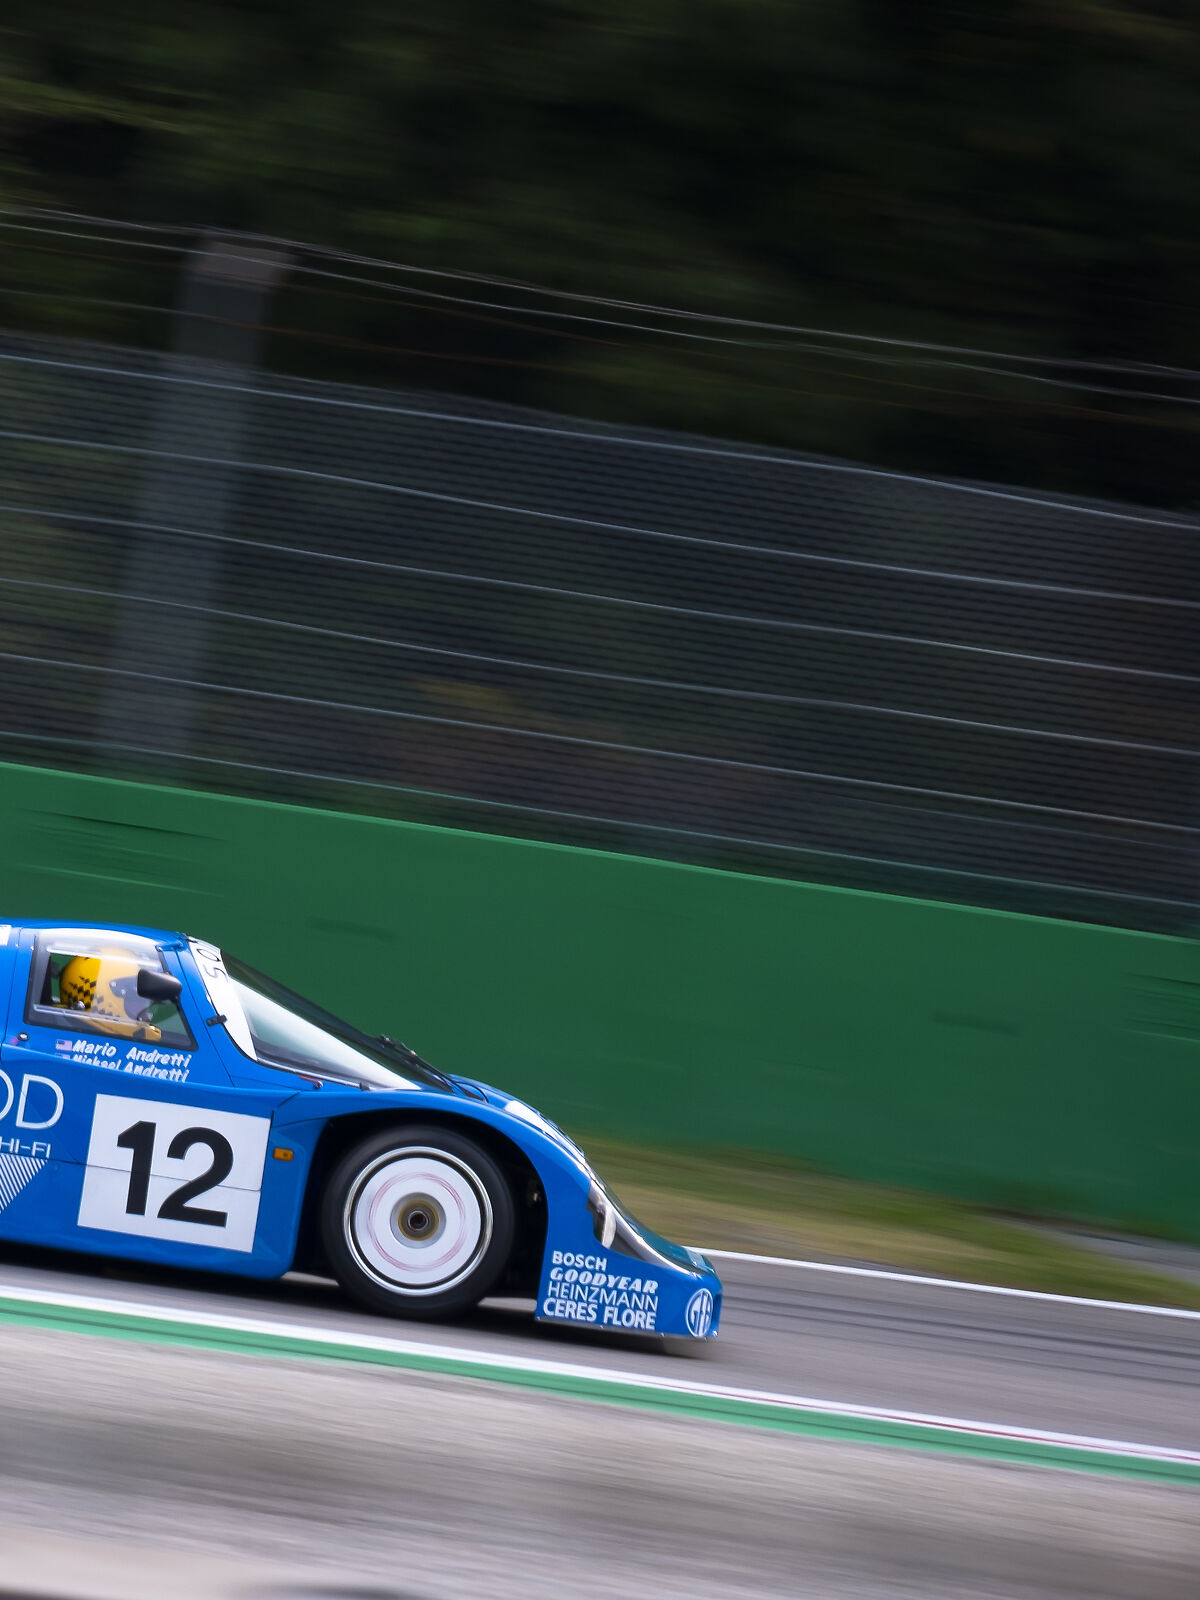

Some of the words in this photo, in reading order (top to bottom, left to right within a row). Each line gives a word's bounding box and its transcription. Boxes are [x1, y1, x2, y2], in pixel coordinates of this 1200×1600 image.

[72, 1040, 117, 1057] Mario
[126, 1047, 192, 1068] Andretti
[116, 1120, 234, 1228] 12
[552, 1250, 608, 1272] BOSCH
[550, 1267, 659, 1294] GOODYEAR
[547, 1281, 659, 1312] HEINZMANN
[543, 1298, 598, 1322] CERES
[603, 1306, 657, 1331] FLORE
